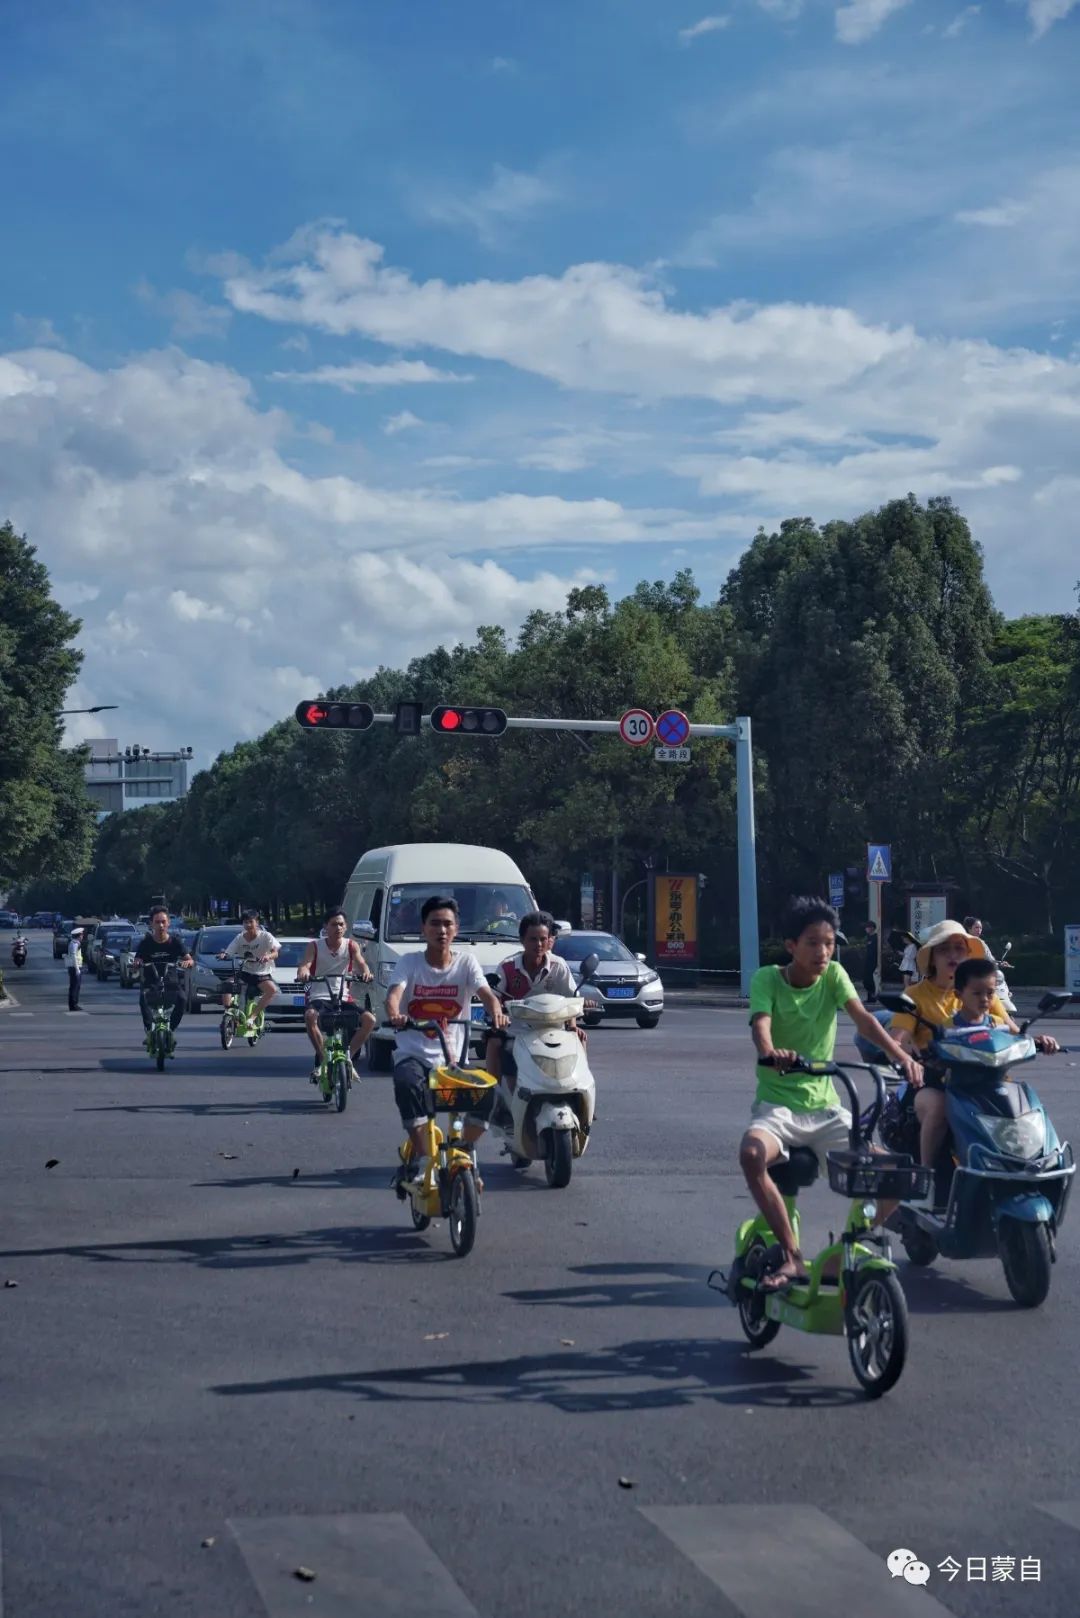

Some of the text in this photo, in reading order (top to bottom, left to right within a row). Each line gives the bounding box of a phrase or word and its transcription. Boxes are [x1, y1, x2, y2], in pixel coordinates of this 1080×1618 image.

[629, 719, 648, 735] 30
[657, 749, 688, 759] 全路段
